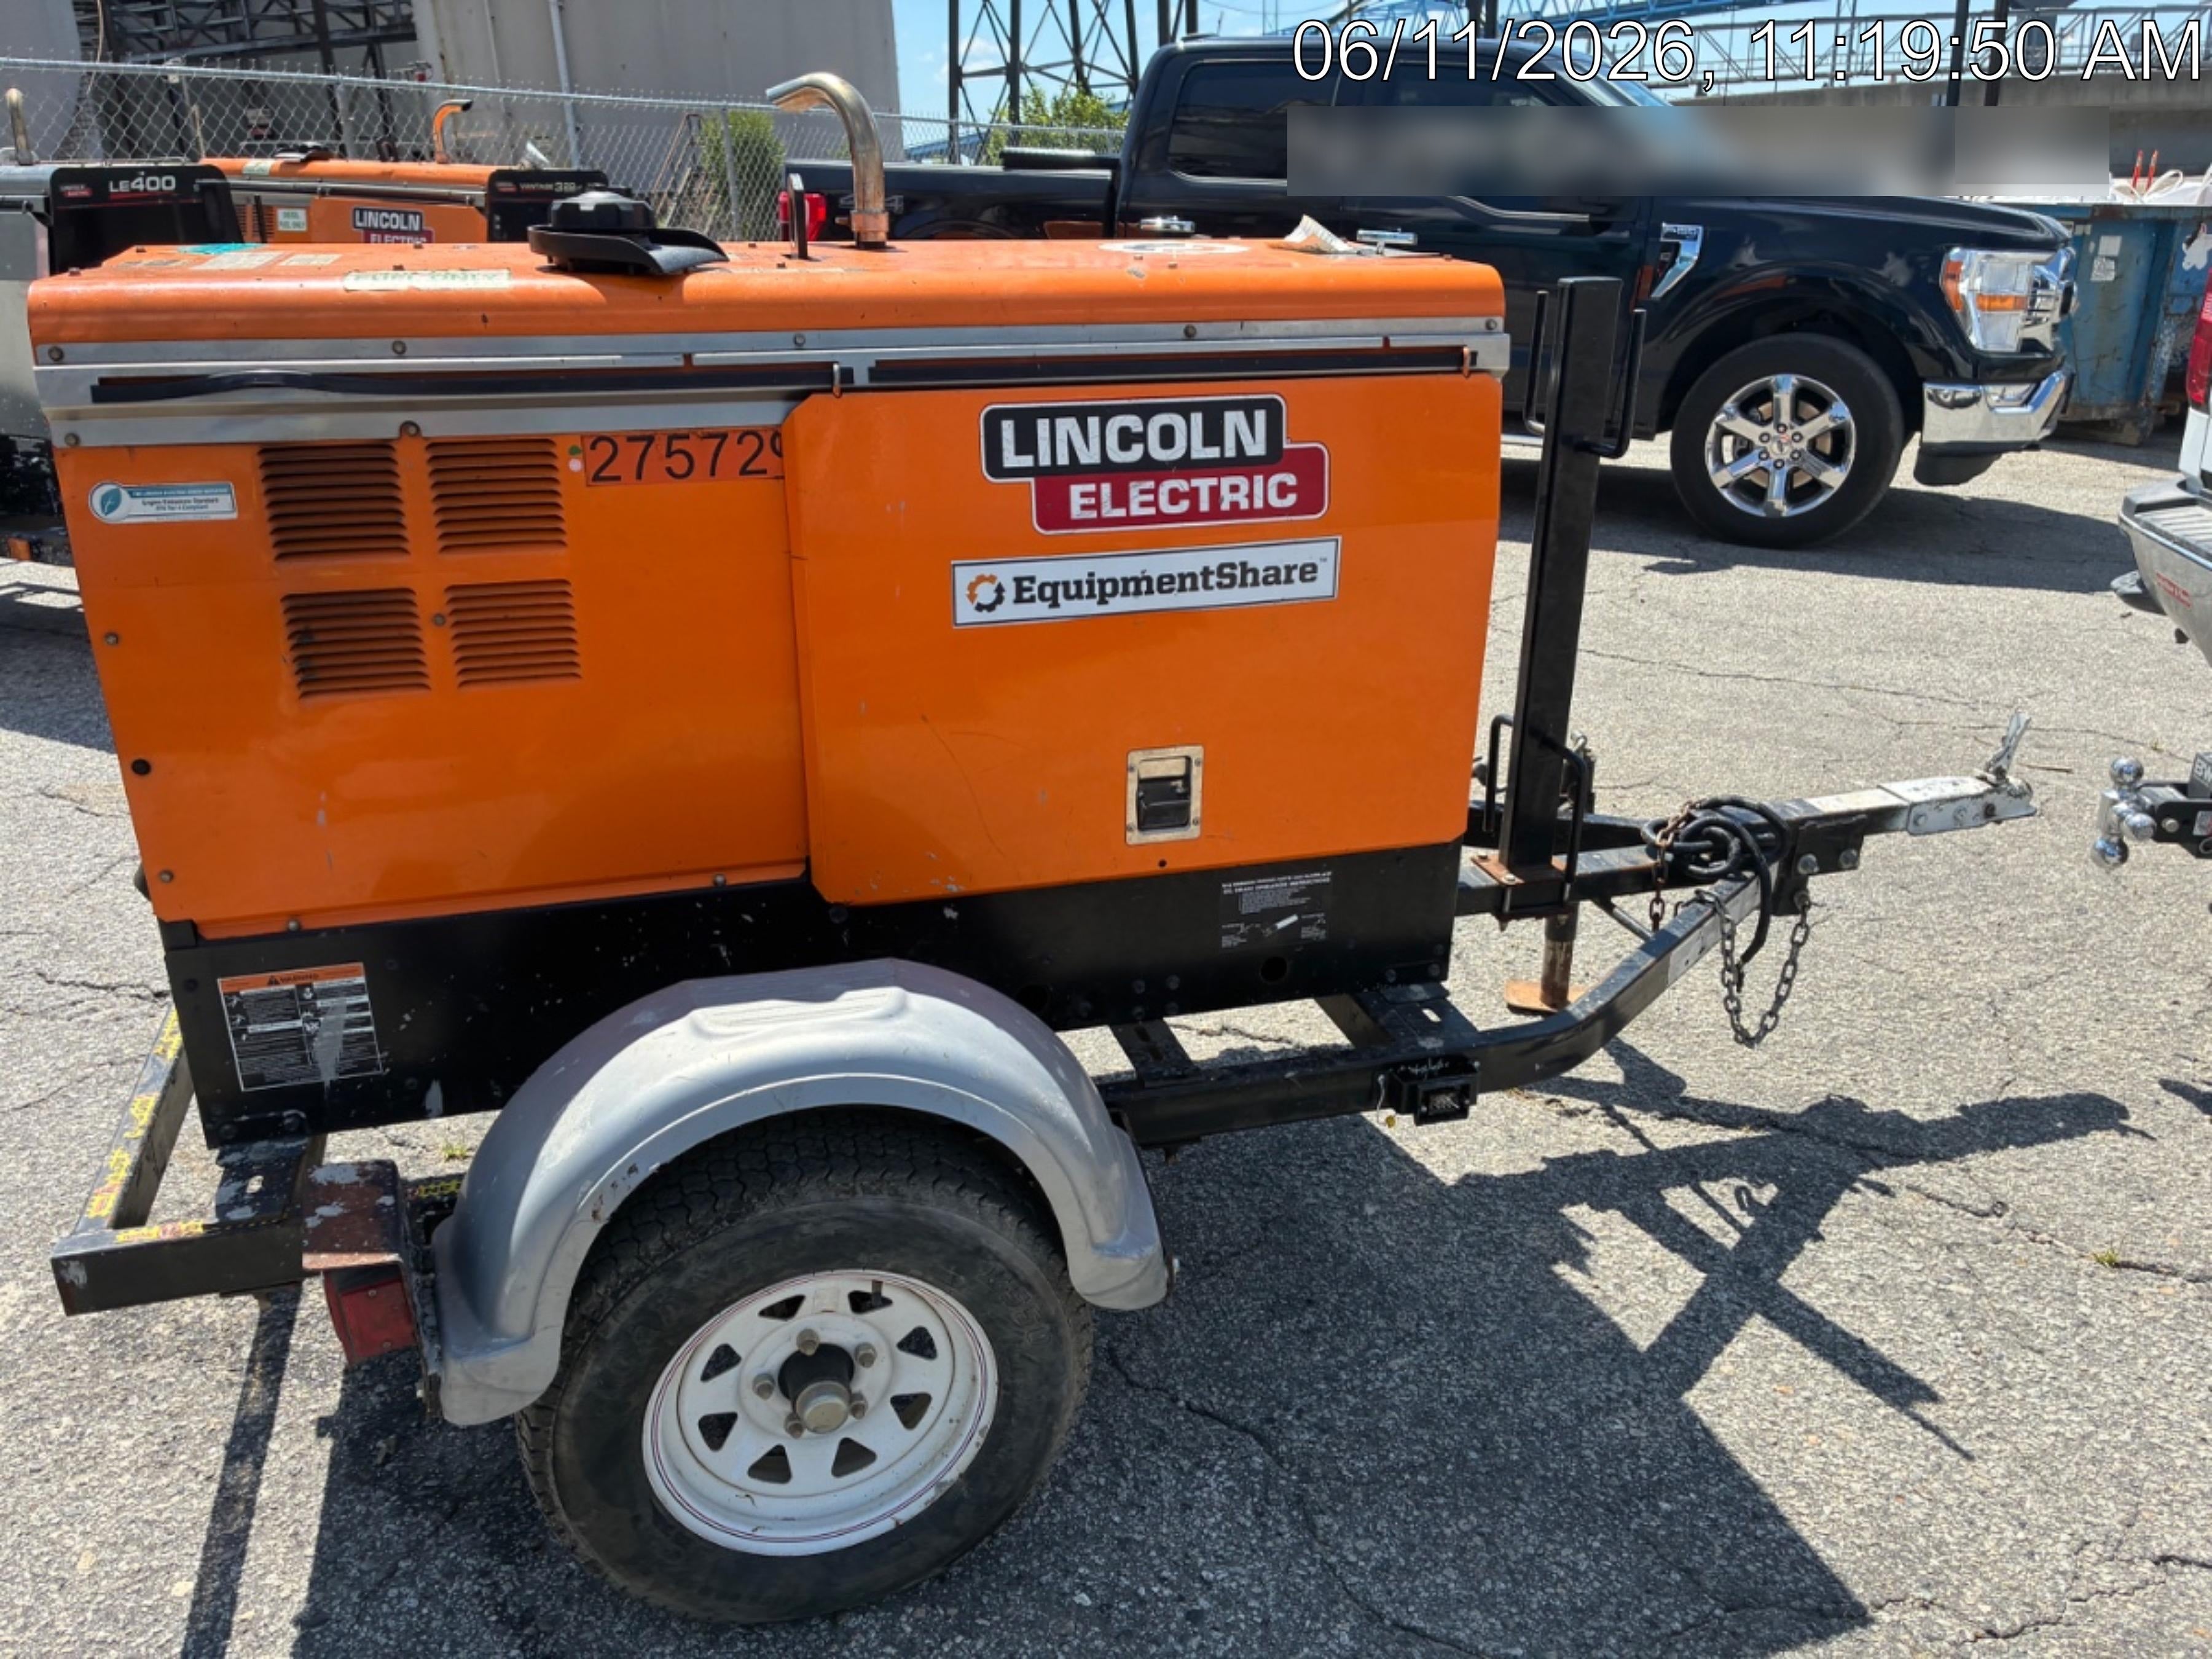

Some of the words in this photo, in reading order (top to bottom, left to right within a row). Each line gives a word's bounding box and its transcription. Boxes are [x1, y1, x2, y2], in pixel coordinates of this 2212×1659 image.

[108, 175, 176, 192] LE400
[355, 210, 420, 231] LINCOLN
[1000, 409, 1267, 469] LINCOLN
[1069, 472, 1298, 520] ELECTRIC
[1012, 560, 1319, 609] EquipmentShare
